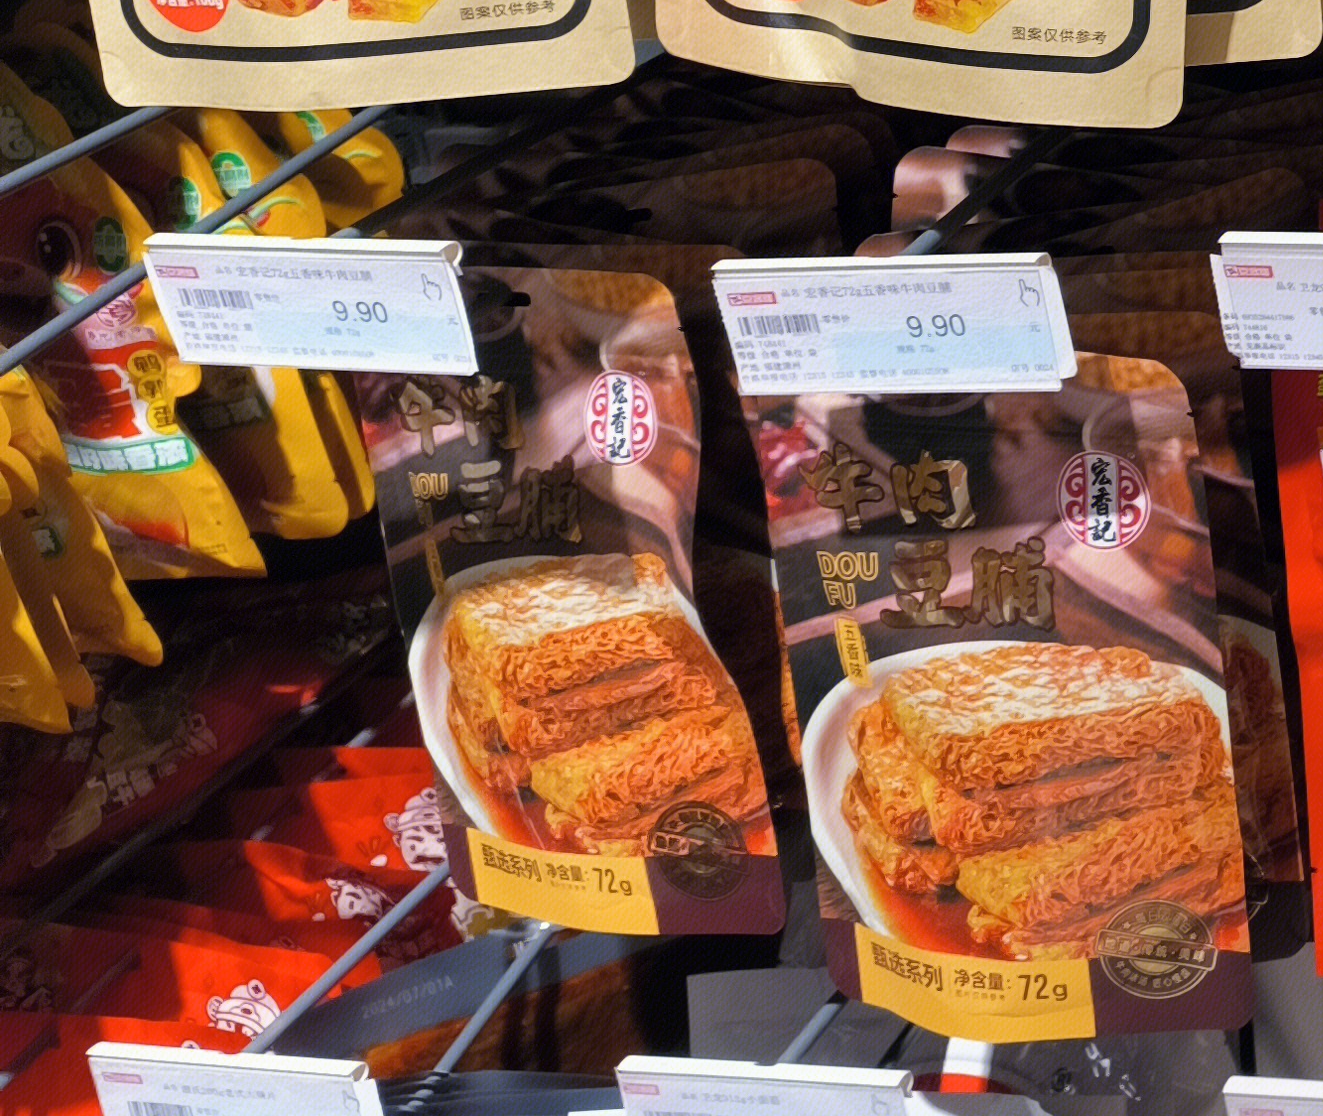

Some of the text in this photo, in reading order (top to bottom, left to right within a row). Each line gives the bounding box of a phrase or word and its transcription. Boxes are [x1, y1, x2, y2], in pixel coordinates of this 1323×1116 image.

[1011, 25, 1107, 46] 图案仅供参考
[332, 300, 389, 324] 9.90
[905, 313, 967, 339] 9.90
[816, 550, 879, 582] DOU
[827, 579, 857, 610] FU
